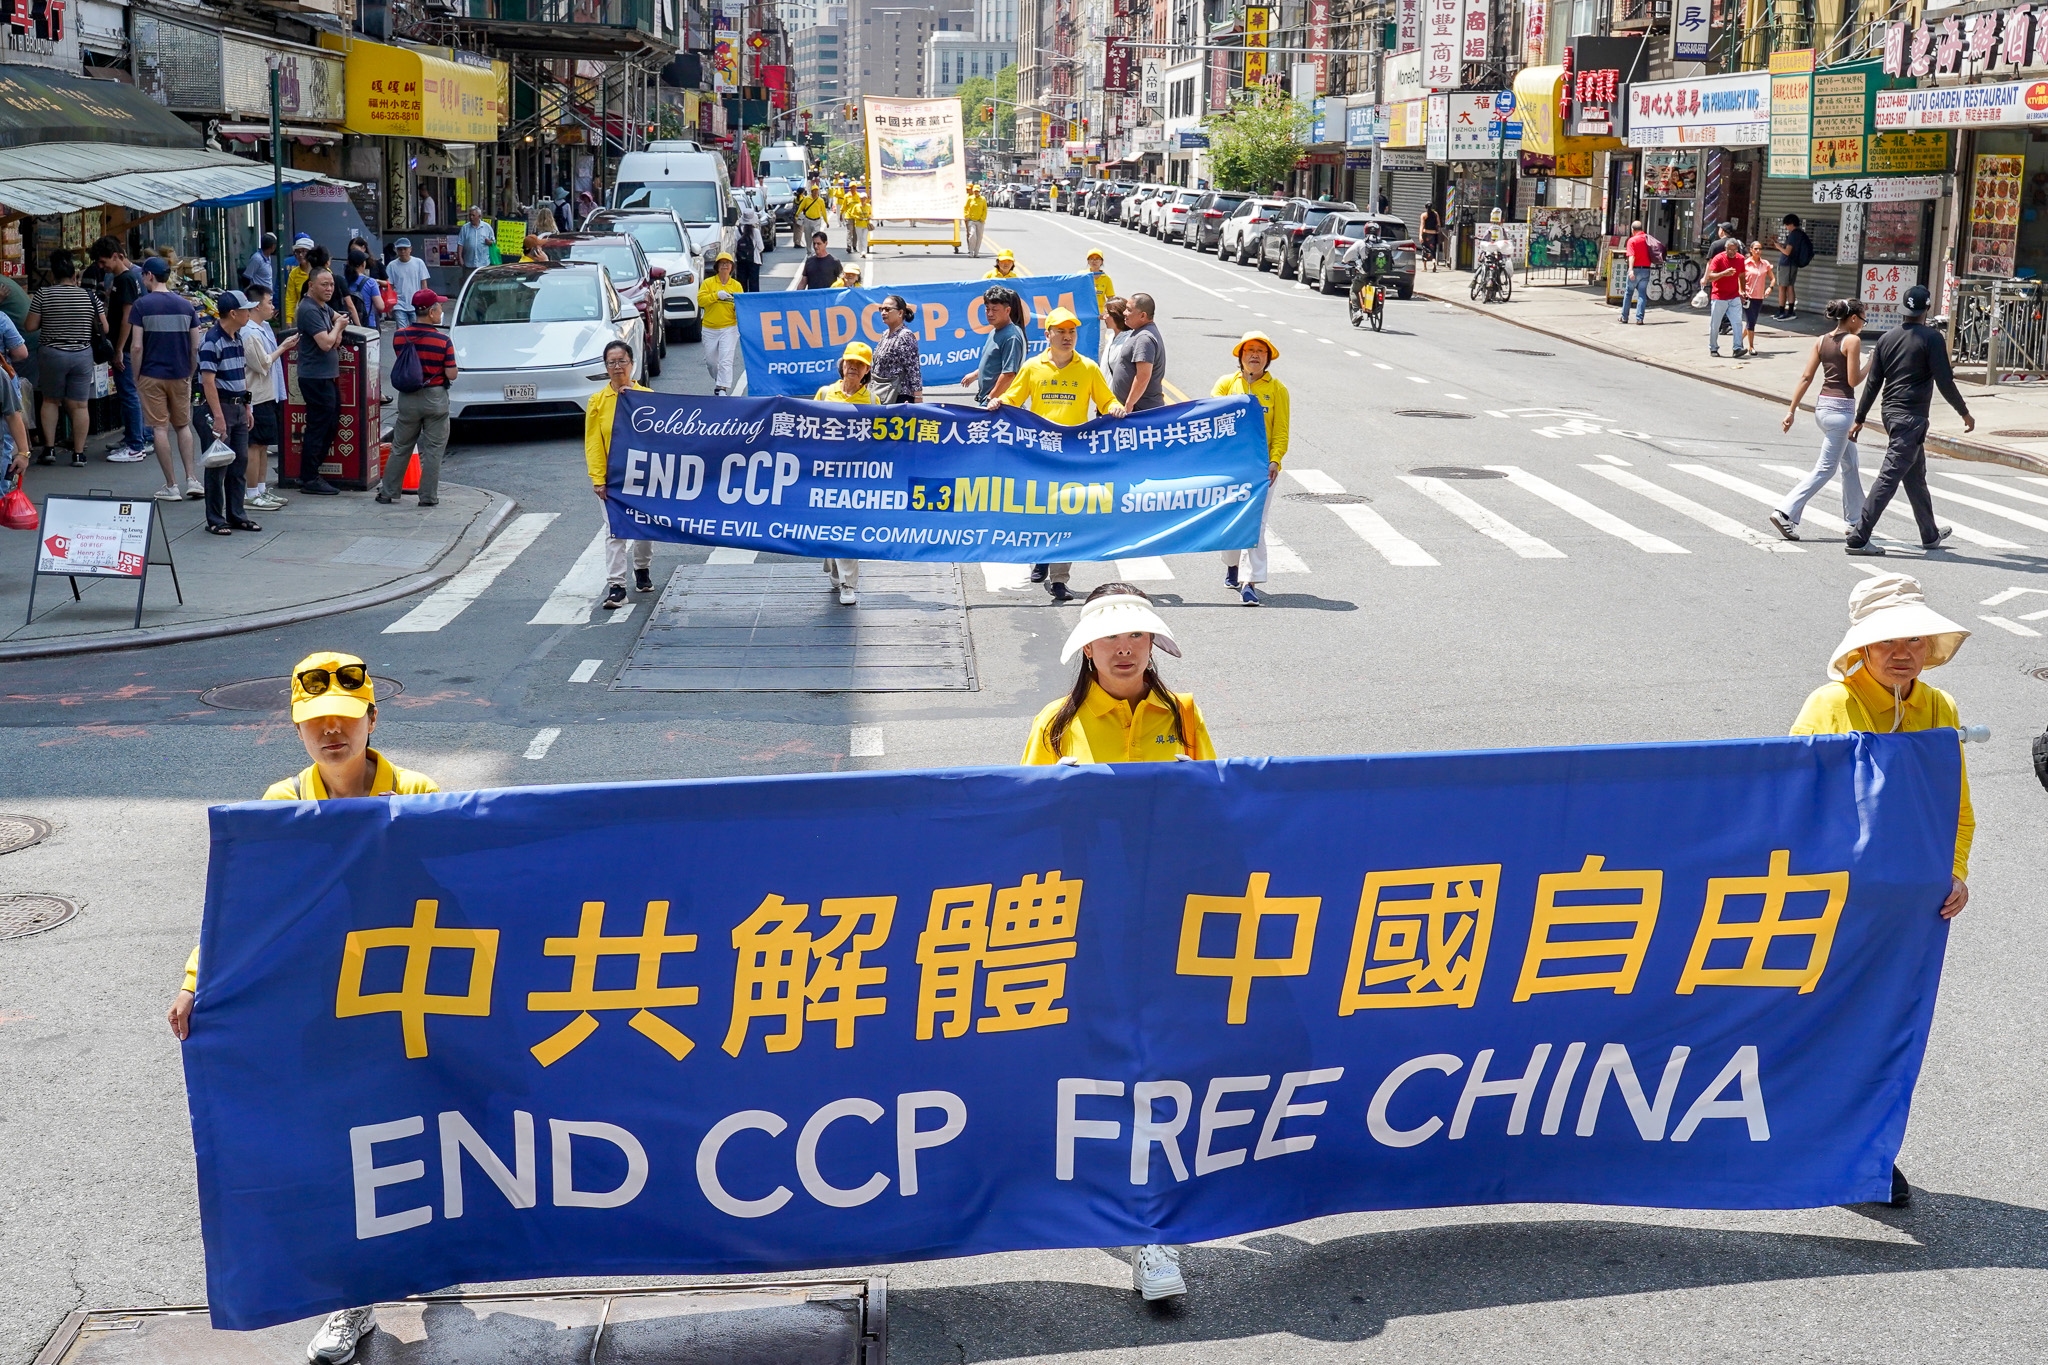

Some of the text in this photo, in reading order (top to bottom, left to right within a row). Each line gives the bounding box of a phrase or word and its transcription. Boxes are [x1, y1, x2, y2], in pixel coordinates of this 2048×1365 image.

[1465, 0, 1487, 57] 商場
[1146, 61, 1158, 104] 大帝國
[368, 98, 421, 110] 福州小吃店
[1474, 96, 1490, 109] 福
[1711, 89, 1747, 113] PHARMACY
[1908, 86, 2019, 112] JUFU GARDEN RESTAURANT
[371, 111, 419, 121] 646-326-8810
[875, 114, 954, 128] 中國共產黨亡
[1457, 111, 1474, 125] 大
[768, 359, 834, 376] PROTECT
[946, 348, 980, 364] SIGN
[630, 405, 764, 444] Celebrating
[621, 448, 801, 506] END CCP
[812, 460, 894, 480] PETITION
[808, 476, 1253, 515] REACHED 5.3 MILLION SIGNATURES
[76, 533, 94, 541] Open
[678, 516, 716, 536] THE
[720, 520, 763, 538] EVIL
[768, 522, 858, 543] CHINESE
[861, 526, 990, 547] COMMUNIST
[334, 849, 1850, 1067] 中共解體 中國自由
[349, 1041, 1771, 1240] END CCP FREE CHINA
